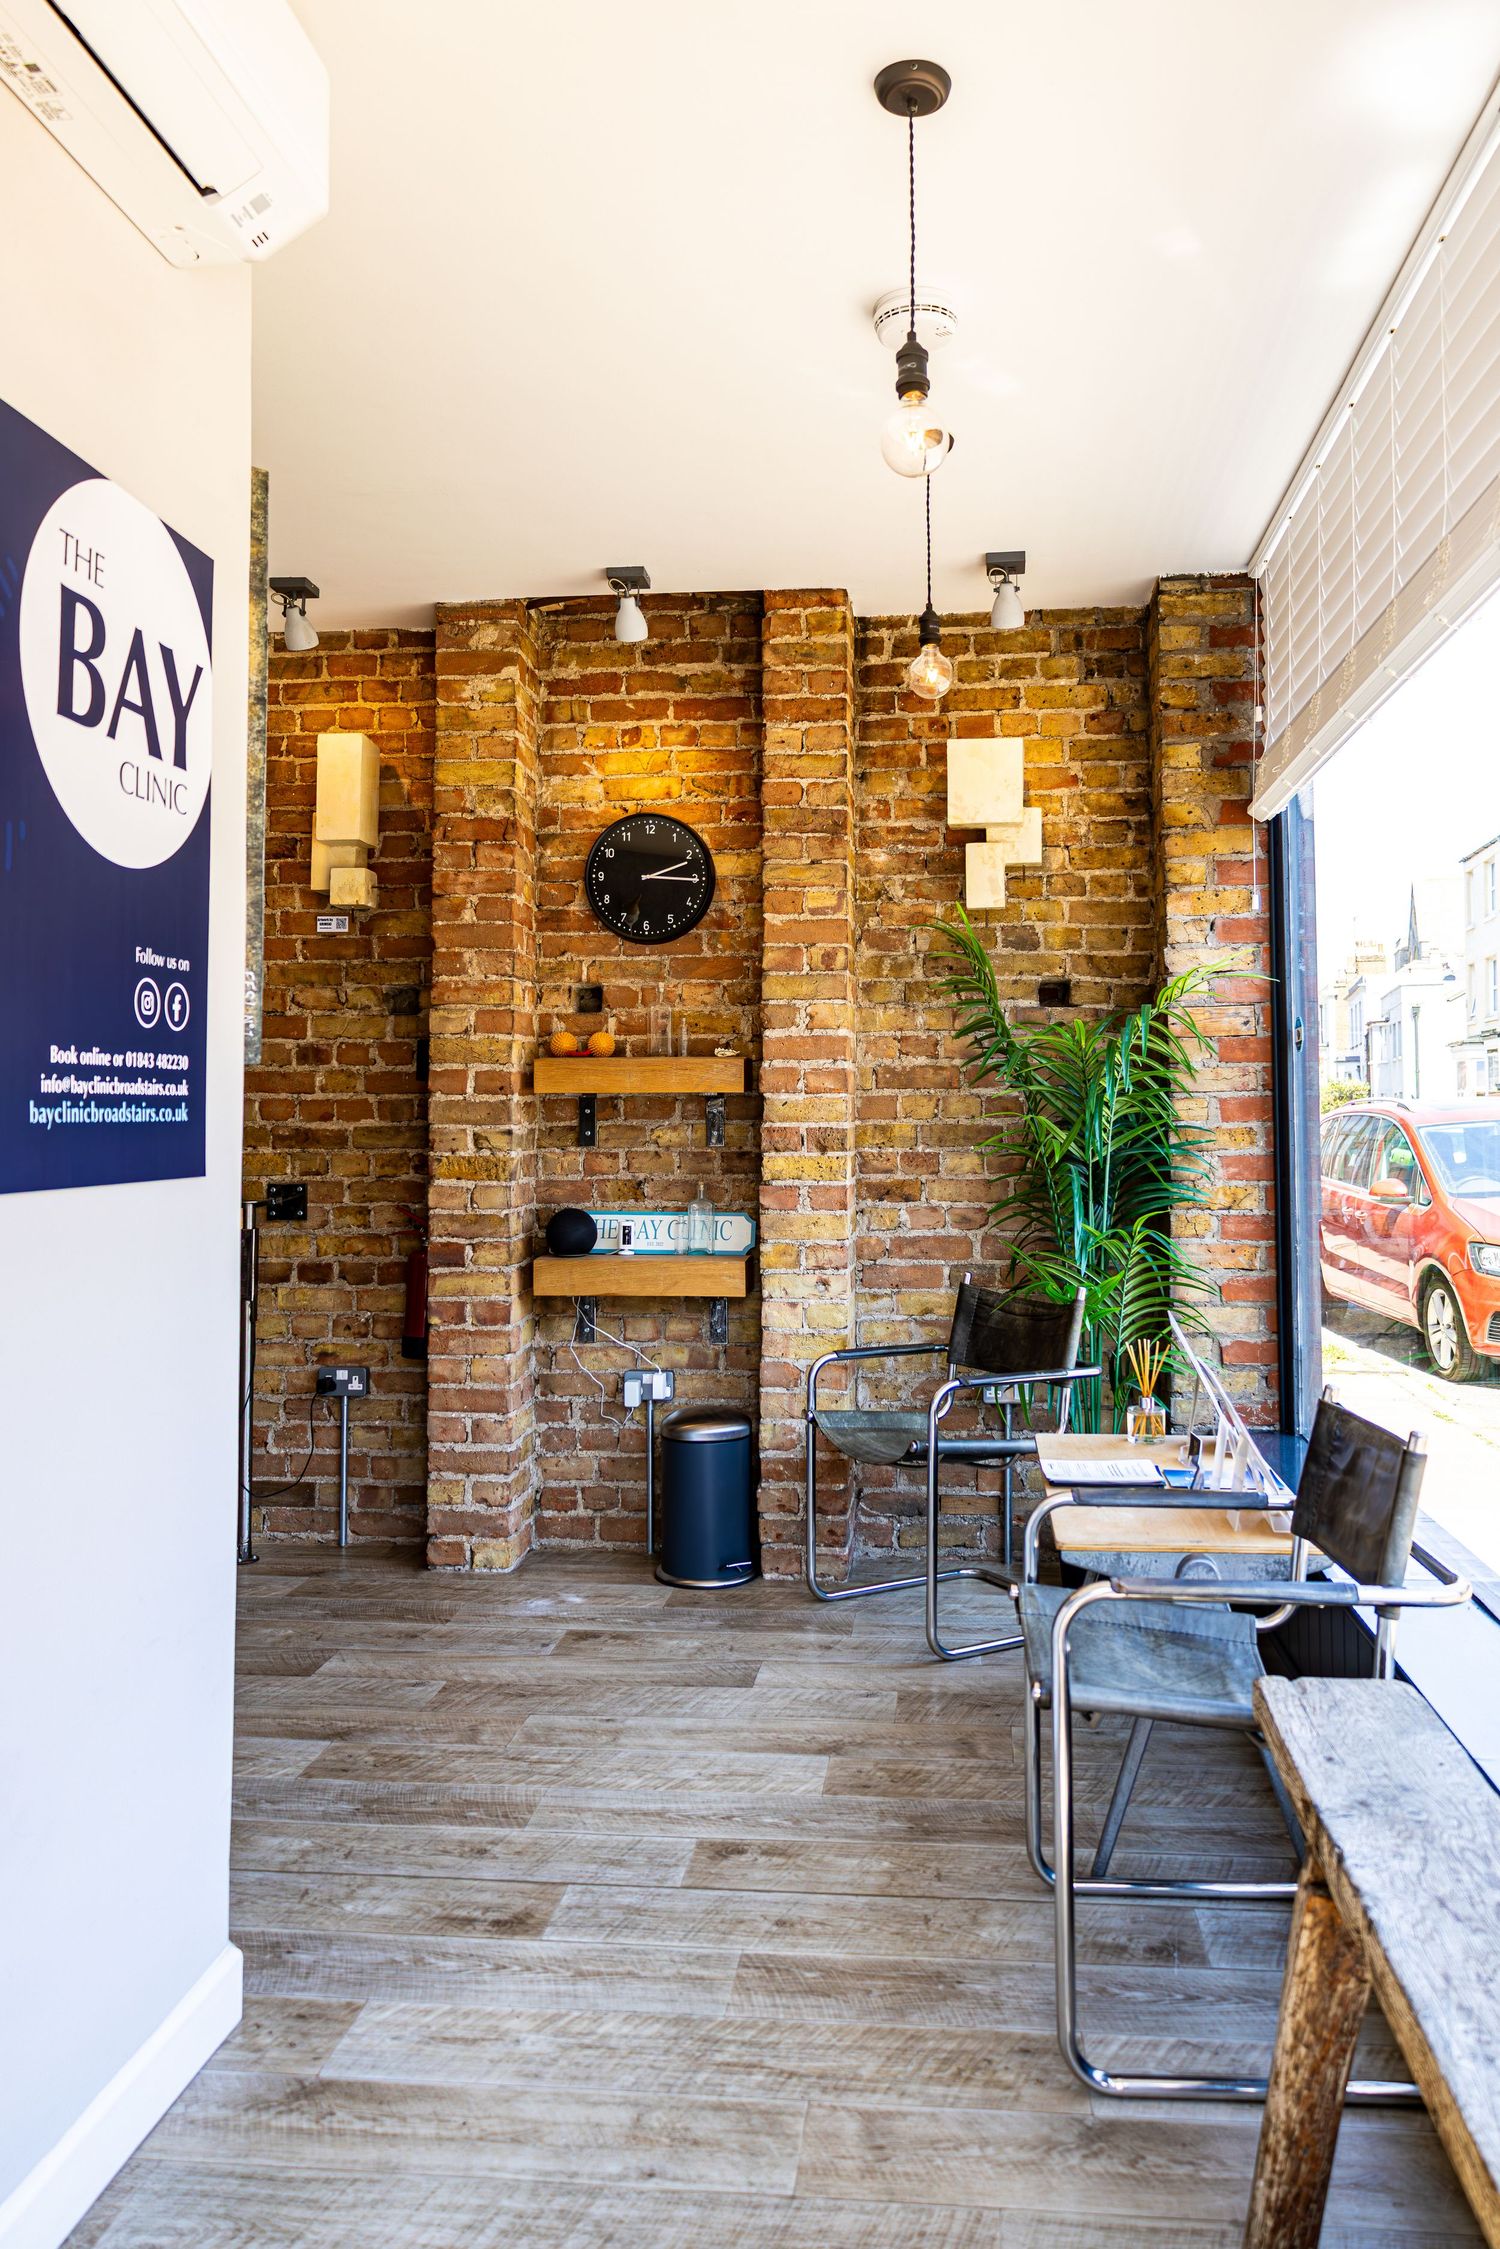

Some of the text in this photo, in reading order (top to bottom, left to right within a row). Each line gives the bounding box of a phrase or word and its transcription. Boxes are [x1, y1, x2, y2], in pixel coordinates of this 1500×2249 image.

[59, 528, 105, 588] THE
[57, 582, 203, 771] BAY
[119, 761, 188, 816] CLINIC
[645, 824, 656, 835] 12
[621, 832, 631, 842] 11
[672, 833, 677, 842] 1
[604, 848, 615, 858] 10
[686, 850, 692, 860] 2
[598, 872, 605, 881] 9
[692, 874, 698, 883] 3
[604, 894, 610, 904] 8
[686, 897, 692, 906] 4
[621, 913, 627, 922] 7
[667, 914, 674, 924] 5
[643, 921, 650, 930] 6
[135, 946, 190, 972] Follow us on
[50, 1044, 189, 1071] Book online or 01843 482230
[40, 1073, 189, 1100] info@bayclinicbroadstairs.co.uk
[29, 1099, 189, 1131] bayclinicbroadstairs.co.uk
[595, 1219, 618, 1239] HE
